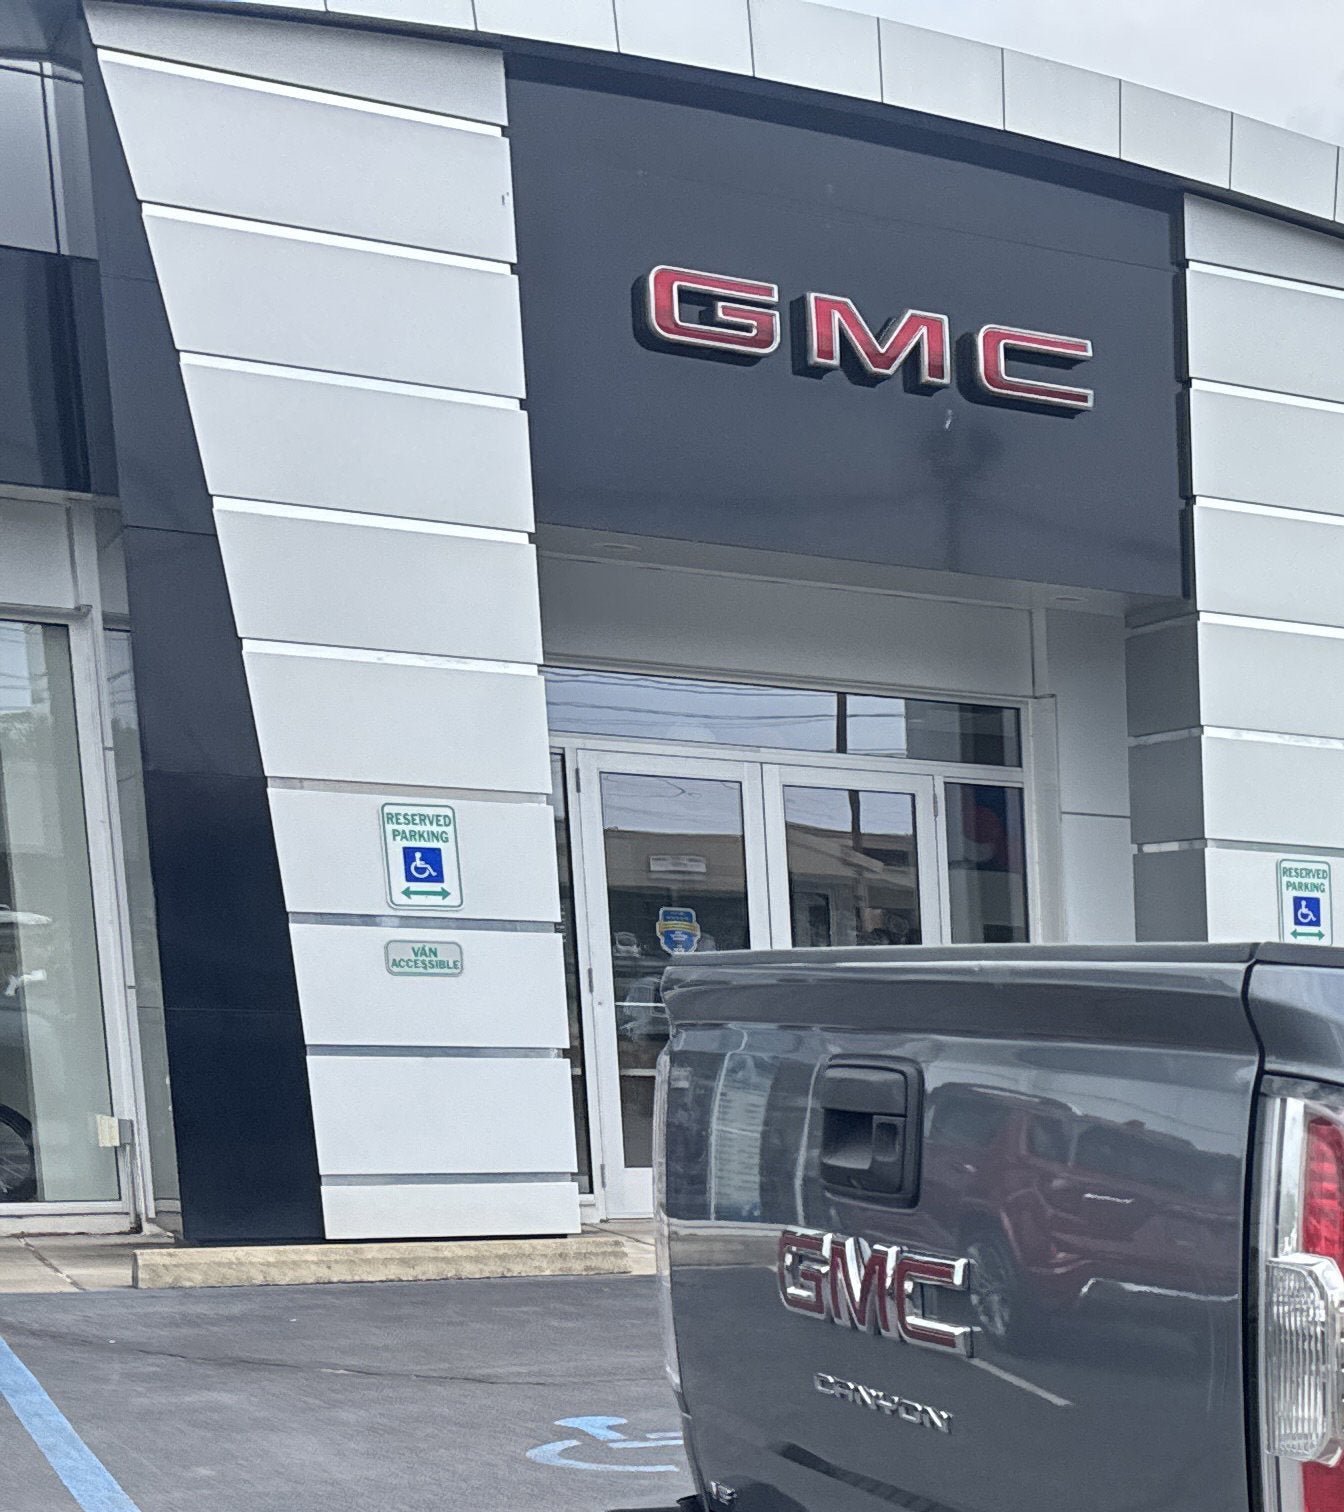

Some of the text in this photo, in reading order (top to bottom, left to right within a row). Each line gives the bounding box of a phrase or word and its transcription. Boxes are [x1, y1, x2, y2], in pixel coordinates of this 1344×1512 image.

[647, 264, 1095, 409] GMC
[386, 812, 452, 827] RESERVED
[391, 828, 449, 843] PARKING
[1282, 867, 1329, 880] RESERVED
[1285, 881, 1326, 893] PARKING
[411, 945, 438, 958] VAN
[390, 958, 460, 971] ACCESSIBLE
[779, 1230, 976, 1357] GMC
[814, 1372, 952, 1434] CANYON
